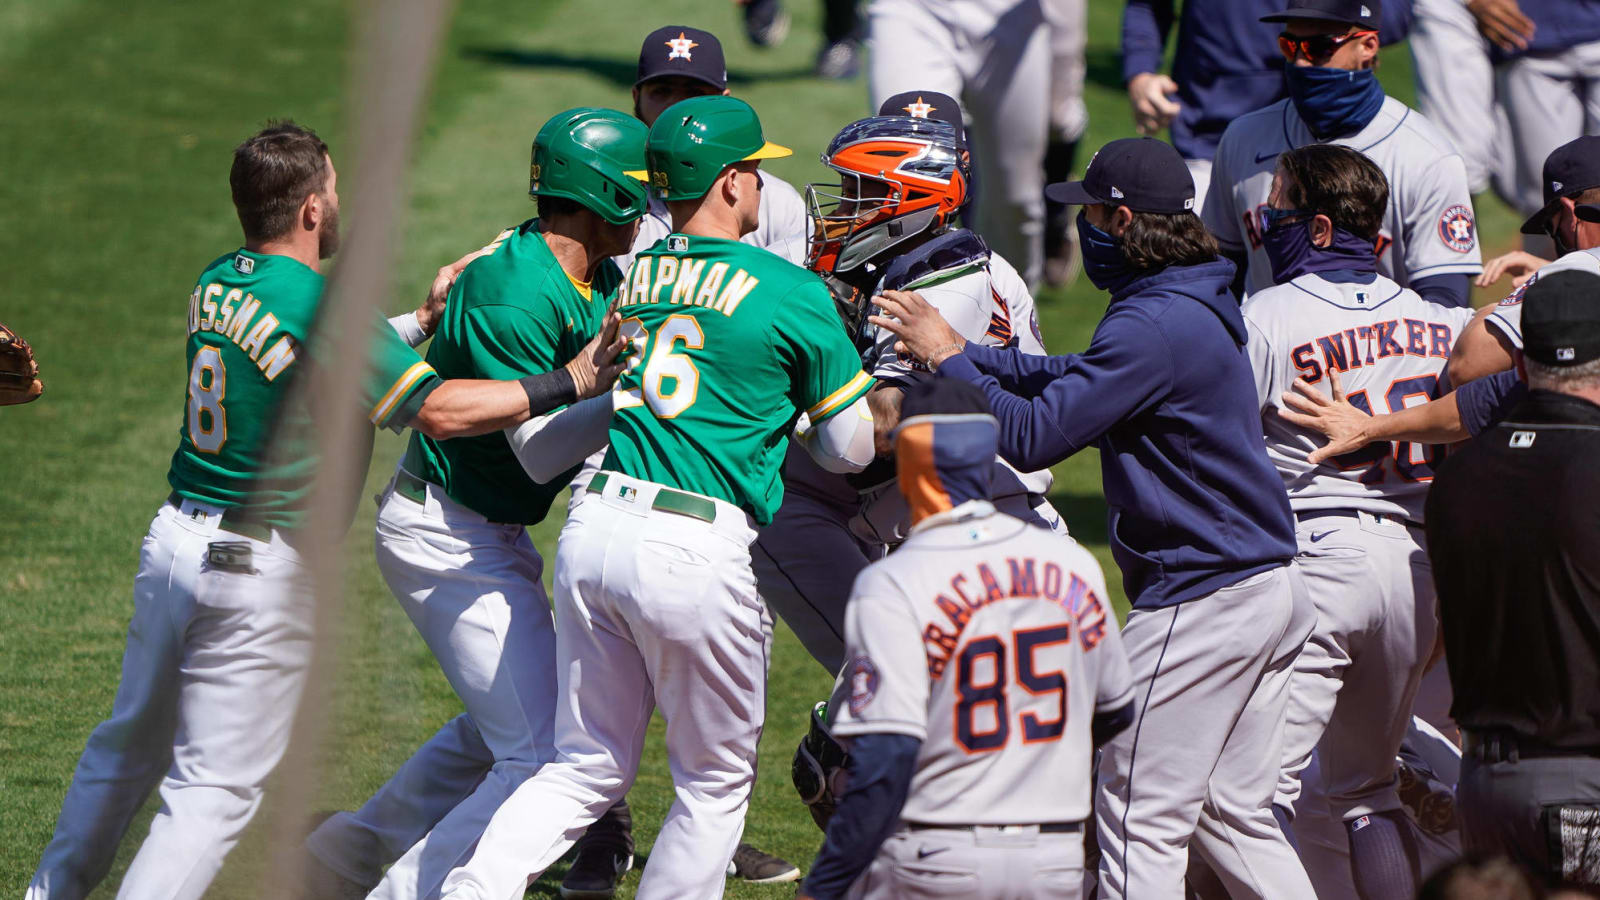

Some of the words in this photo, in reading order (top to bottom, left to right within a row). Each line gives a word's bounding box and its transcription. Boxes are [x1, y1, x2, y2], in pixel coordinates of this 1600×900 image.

[188, 344, 227, 455] 8
[612, 313, 705, 420] 26
[1290, 317, 1453, 386] SNITKER
[922, 558, 1108, 681] BRACAMONTE
[953, 622, 1072, 756] 85
